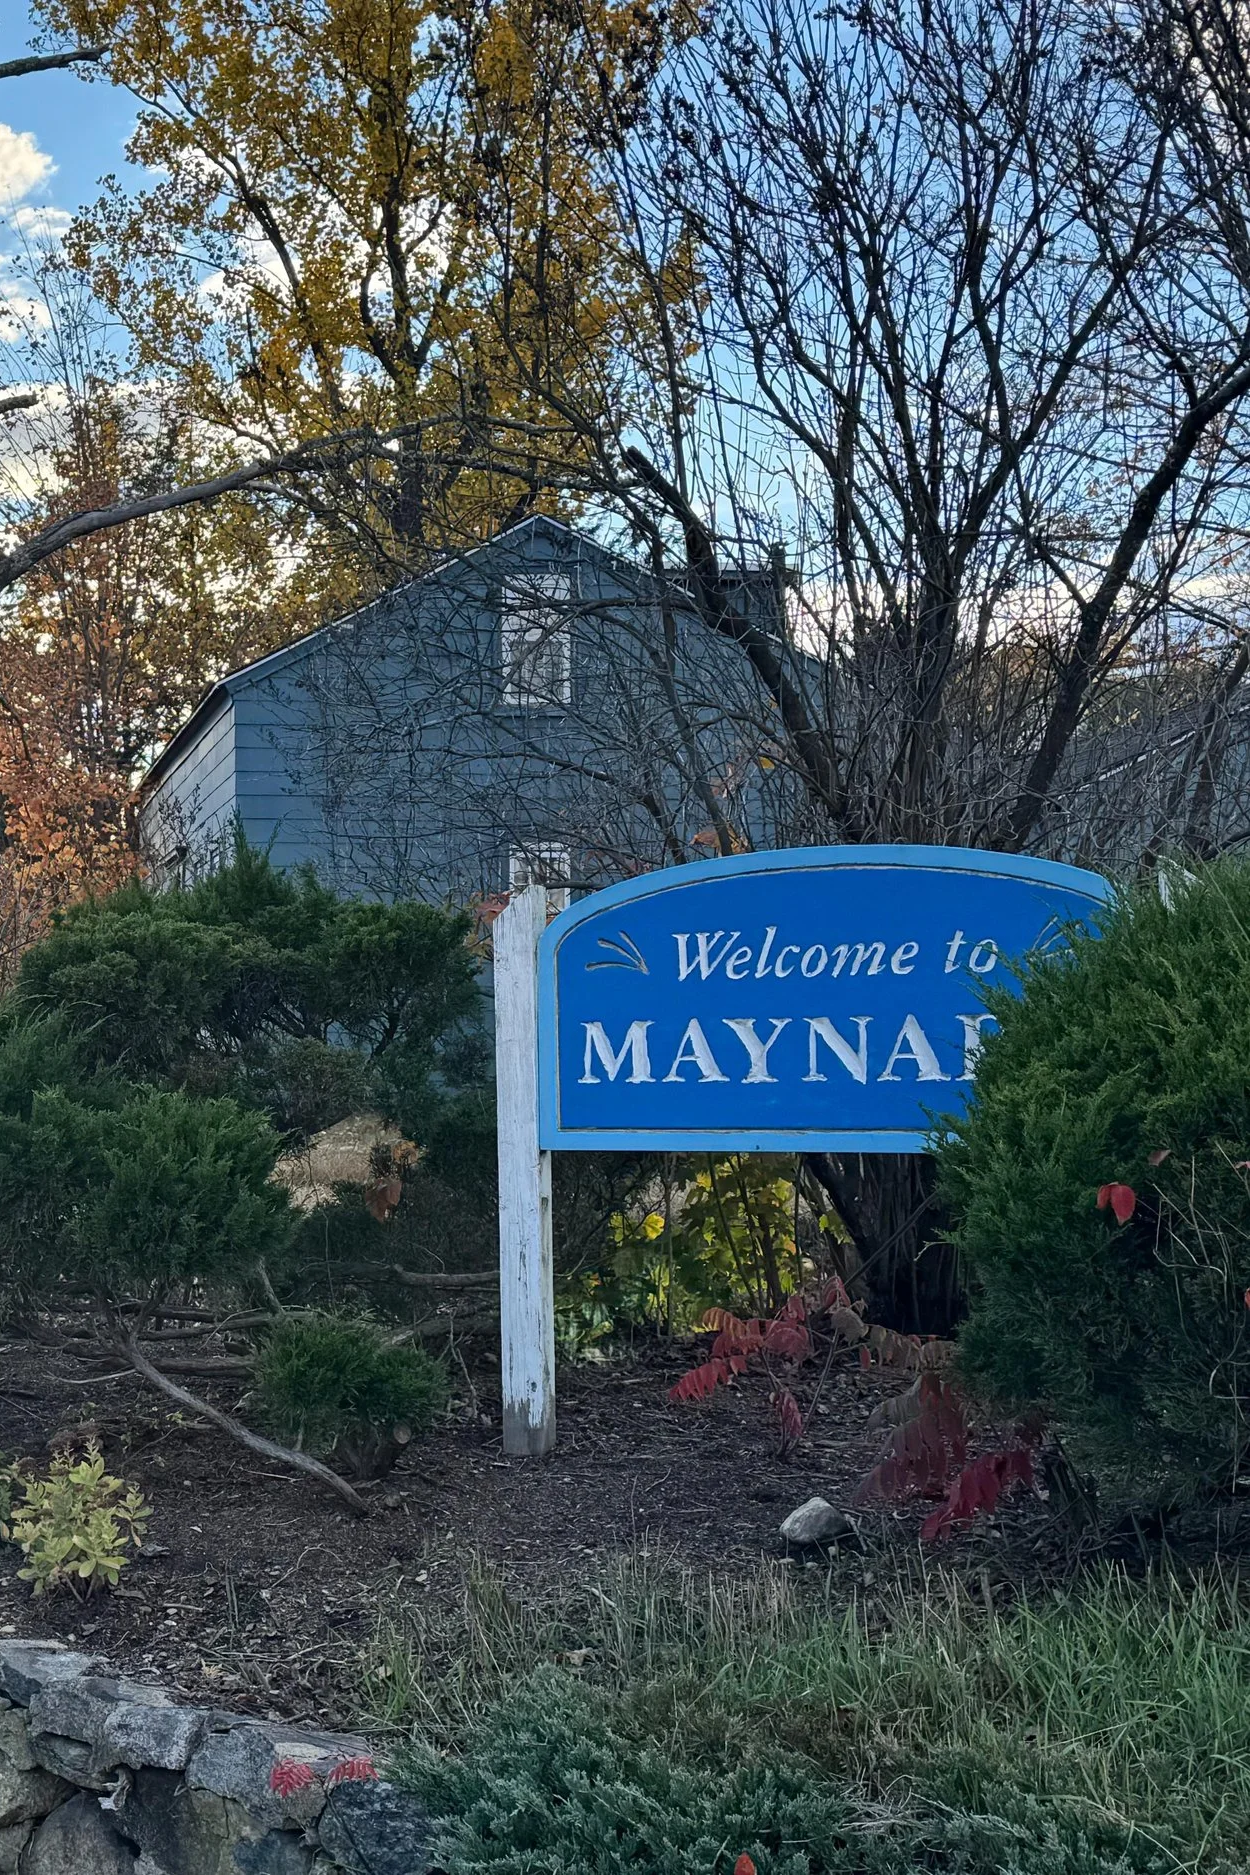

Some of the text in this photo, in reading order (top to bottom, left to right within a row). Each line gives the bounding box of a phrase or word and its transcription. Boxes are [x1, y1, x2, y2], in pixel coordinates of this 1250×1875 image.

[671, 925, 999, 982] Welcome to
[577, 1012, 998, 1085] MAYNA
